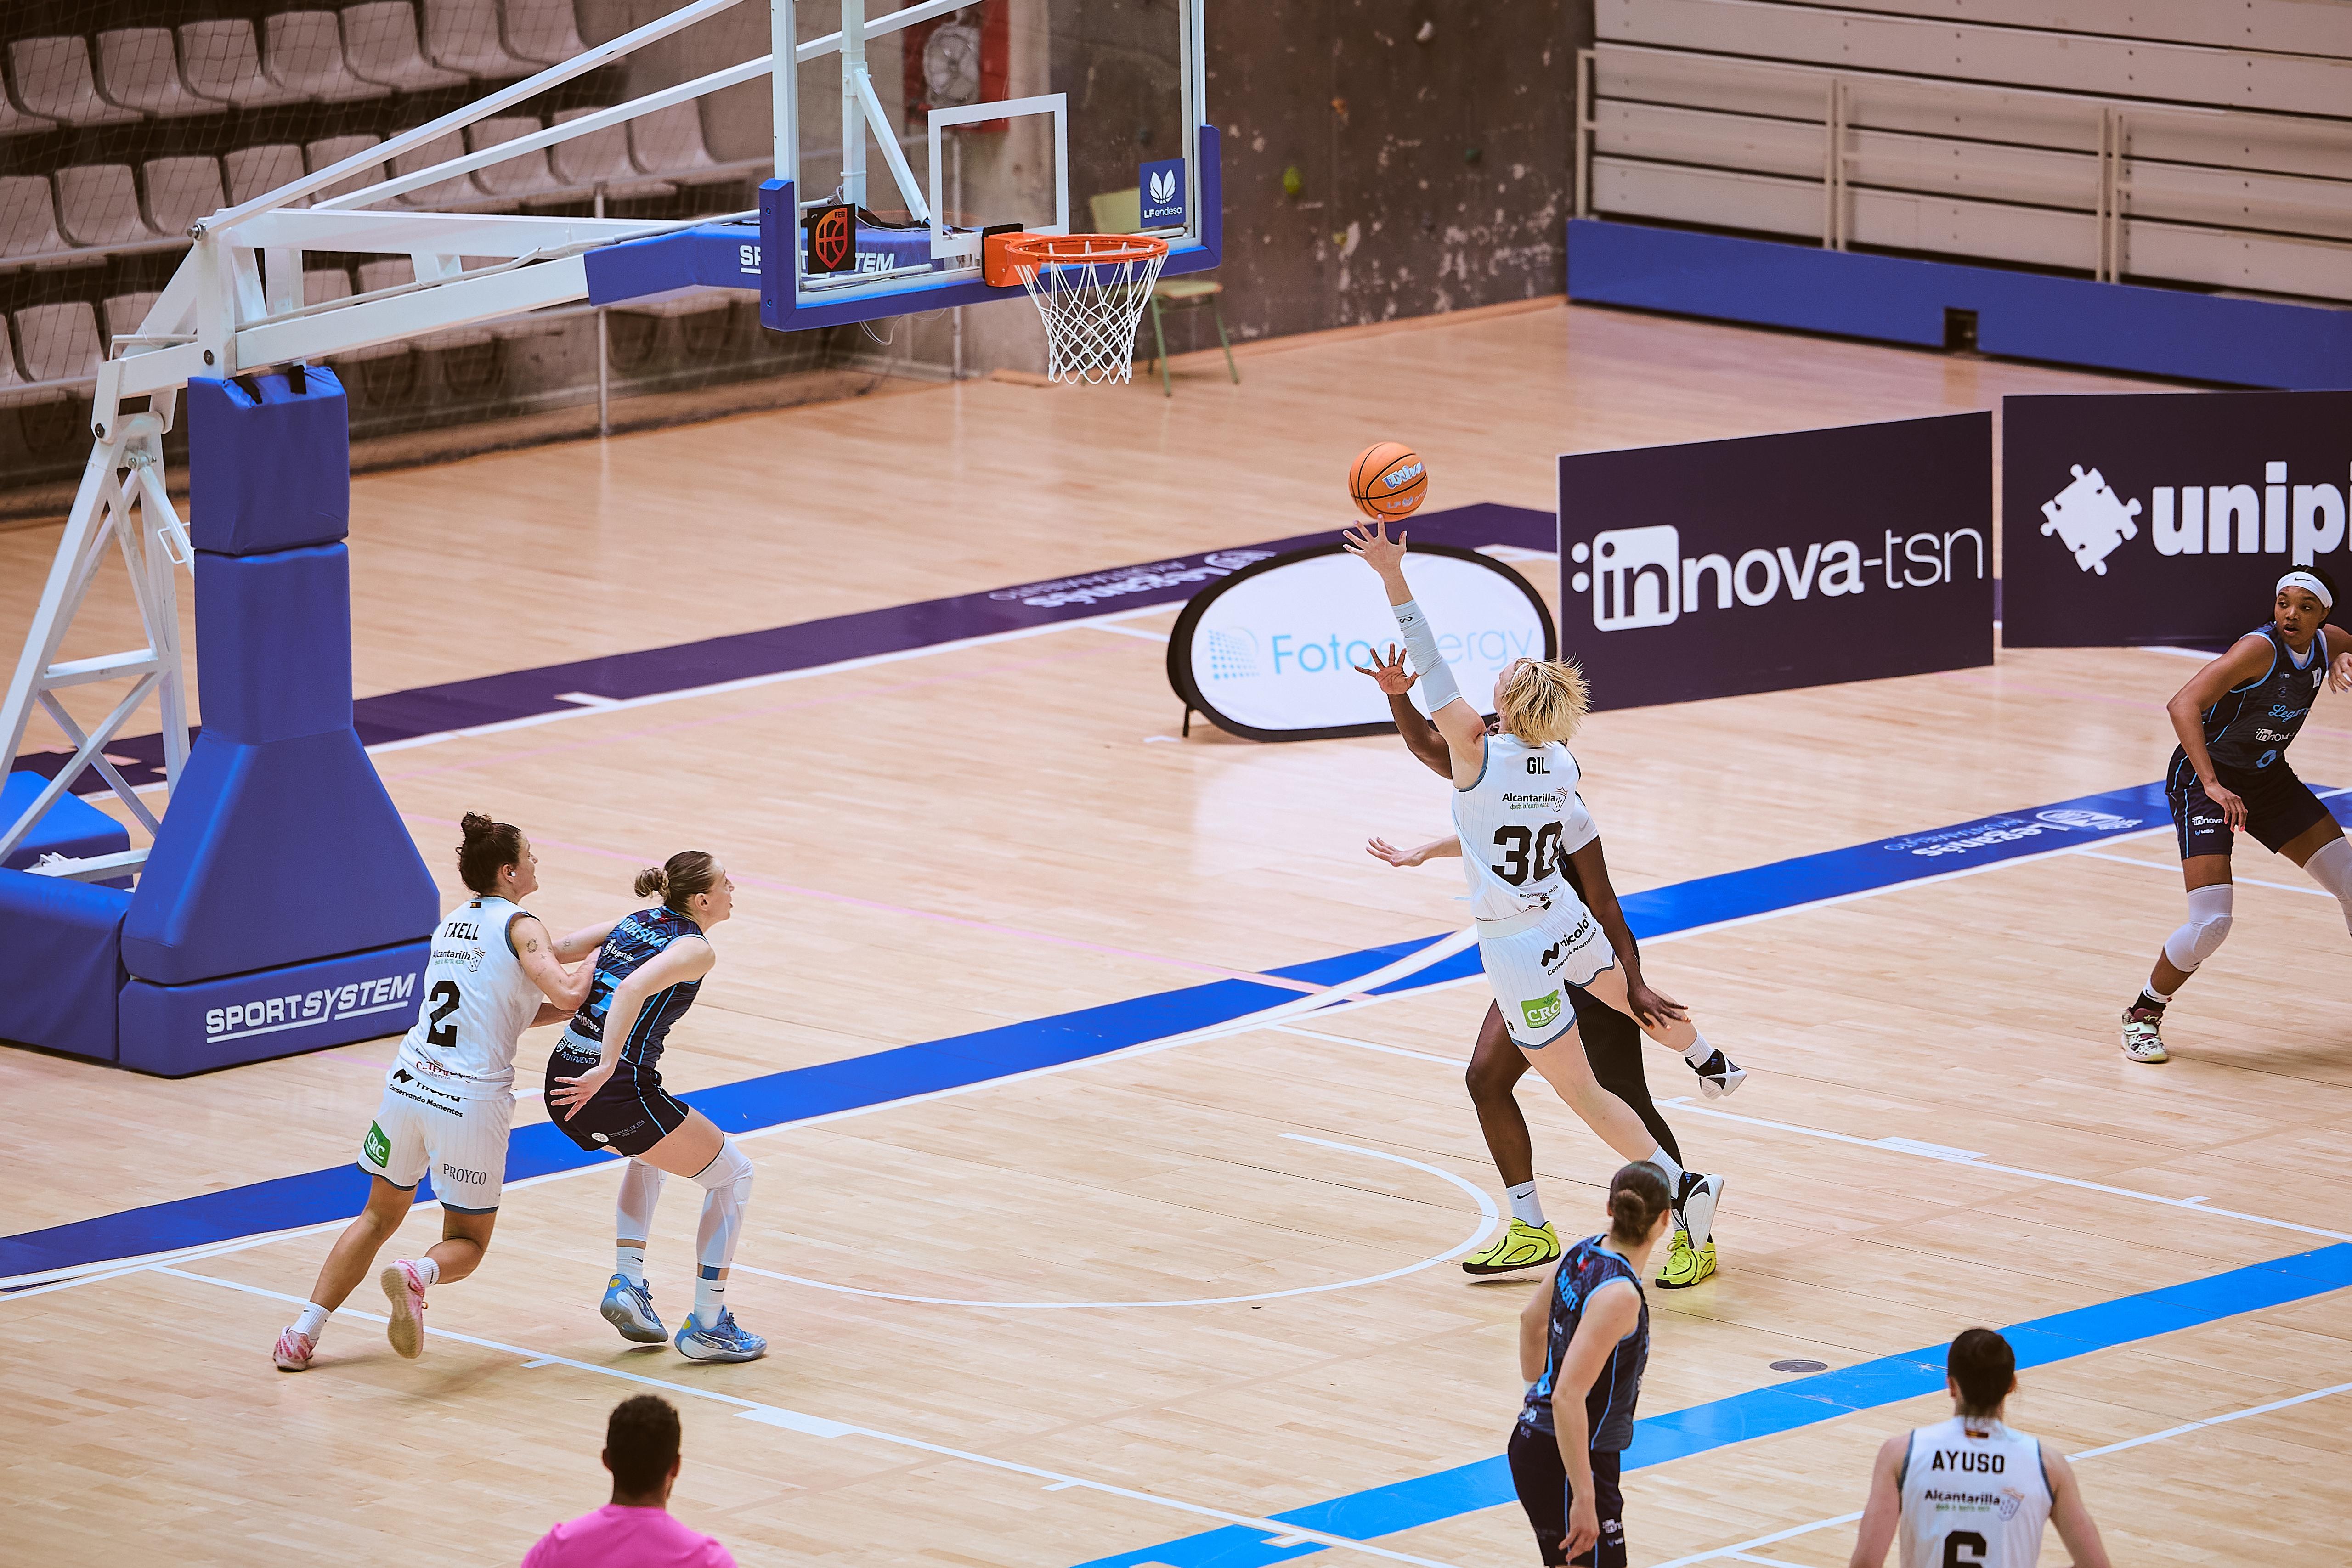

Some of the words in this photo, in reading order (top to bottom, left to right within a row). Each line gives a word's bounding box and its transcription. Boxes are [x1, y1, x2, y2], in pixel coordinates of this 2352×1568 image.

[2152, 461, 2352, 567] unip
[1272, 629, 1533, 674] Fotoeergy
[1527, 757, 1550, 774] GIL
[1502, 793, 1555, 802] Alcantarilla
[1491, 821, 1563, 886] 30
[444, 922, 479, 941] TXELL
[432, 949, 471, 961] Alcantarilla
[426, 980, 461, 1048] 2
[1527, 1000, 1559, 1022] CRC
[426, 1099, 464, 1117] Momentos
[368, 1131, 385, 1160] CRC
[443, 1163, 486, 1185] PROYCO
[1932, 1450, 2005, 1473] AYUSO
[1924, 1488, 2001, 1506] Alcantarilla
[1942, 1530, 1987, 1568] 6
